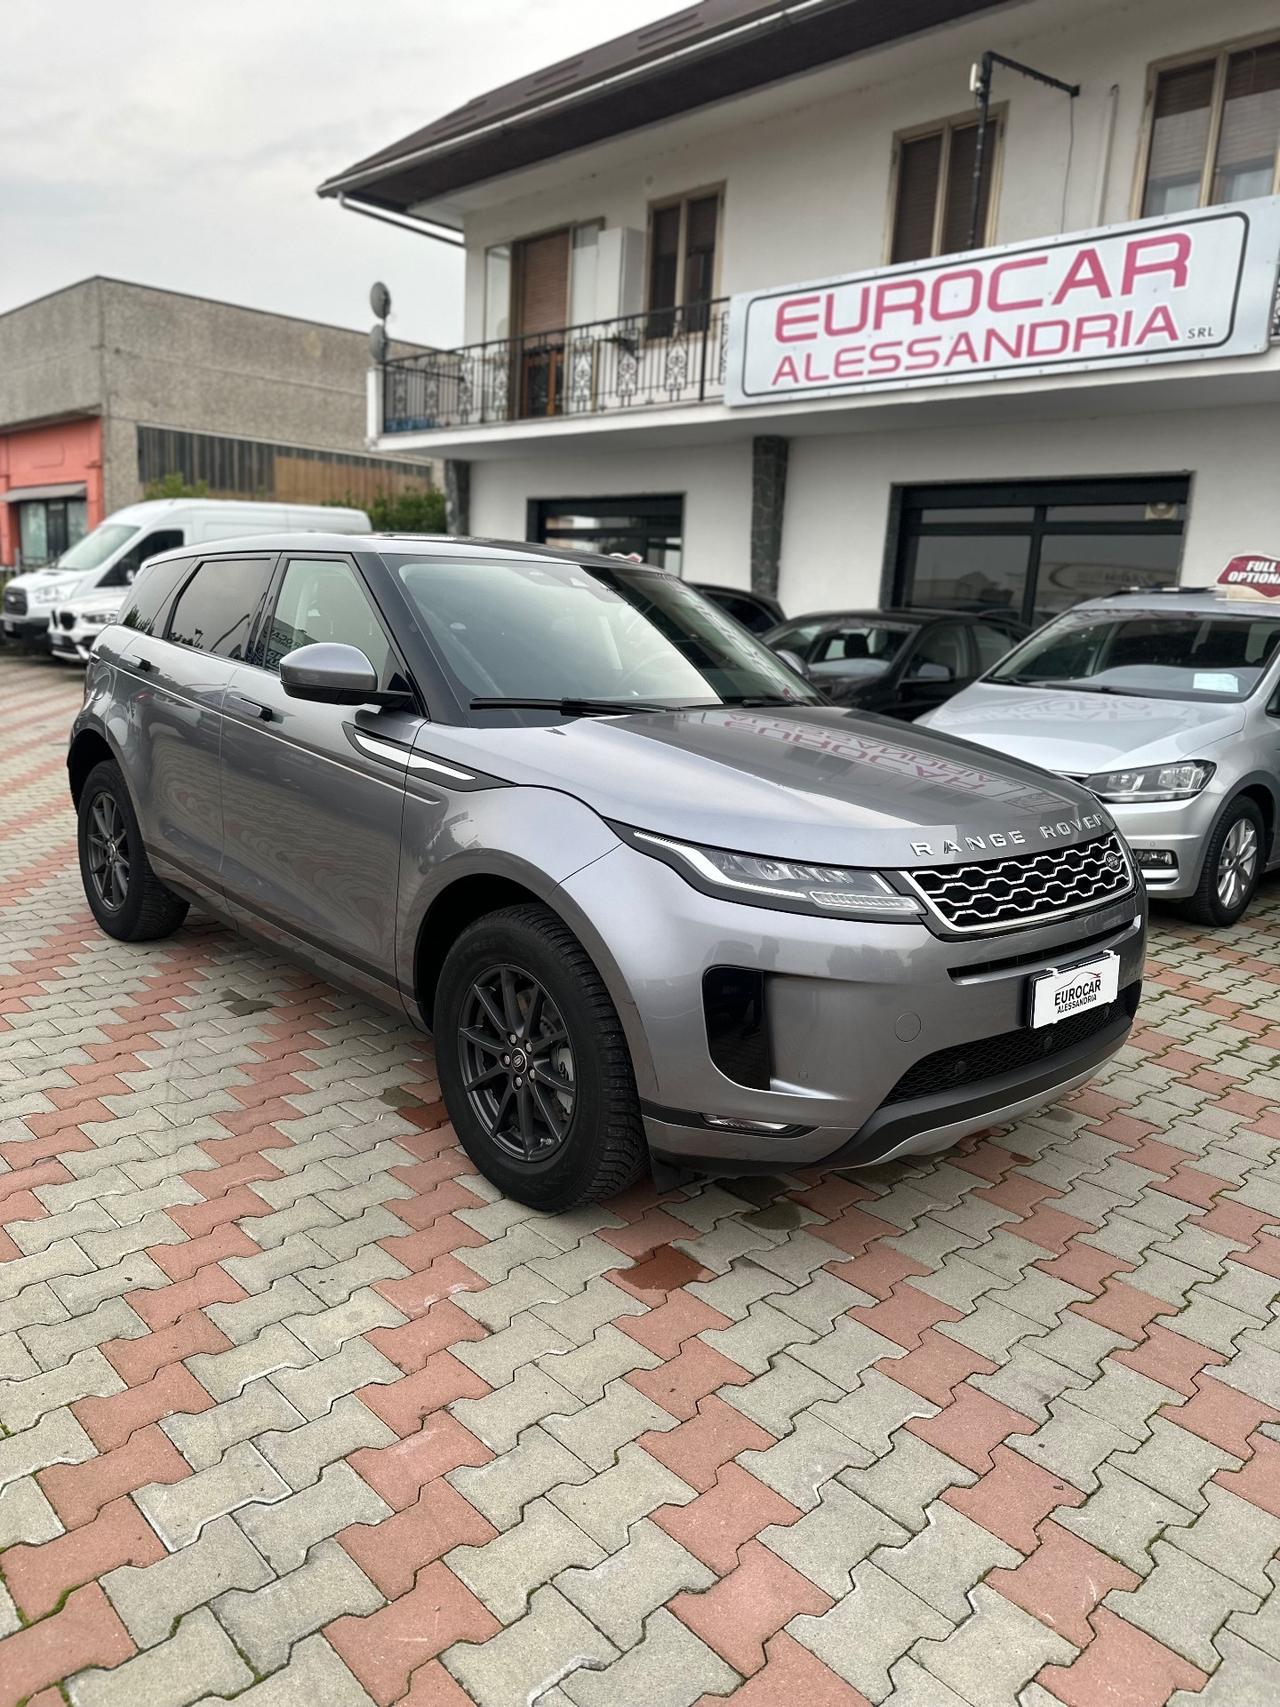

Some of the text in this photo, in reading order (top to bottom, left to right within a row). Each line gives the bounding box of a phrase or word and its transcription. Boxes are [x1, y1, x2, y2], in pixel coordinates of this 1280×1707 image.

[774, 232, 1192, 344] EUROCAR
[771, 305, 1179, 386] ALESSANDRIA
[1187, 326, 1214, 339] SRL
[1246, 560, 1277, 572] FULL
[910, 812, 1106, 856] RANGE ROVER
[1054, 979, 1101, 1006] EUROCAR
[1057, 994, 1097, 1014] ALESSANDRIA
